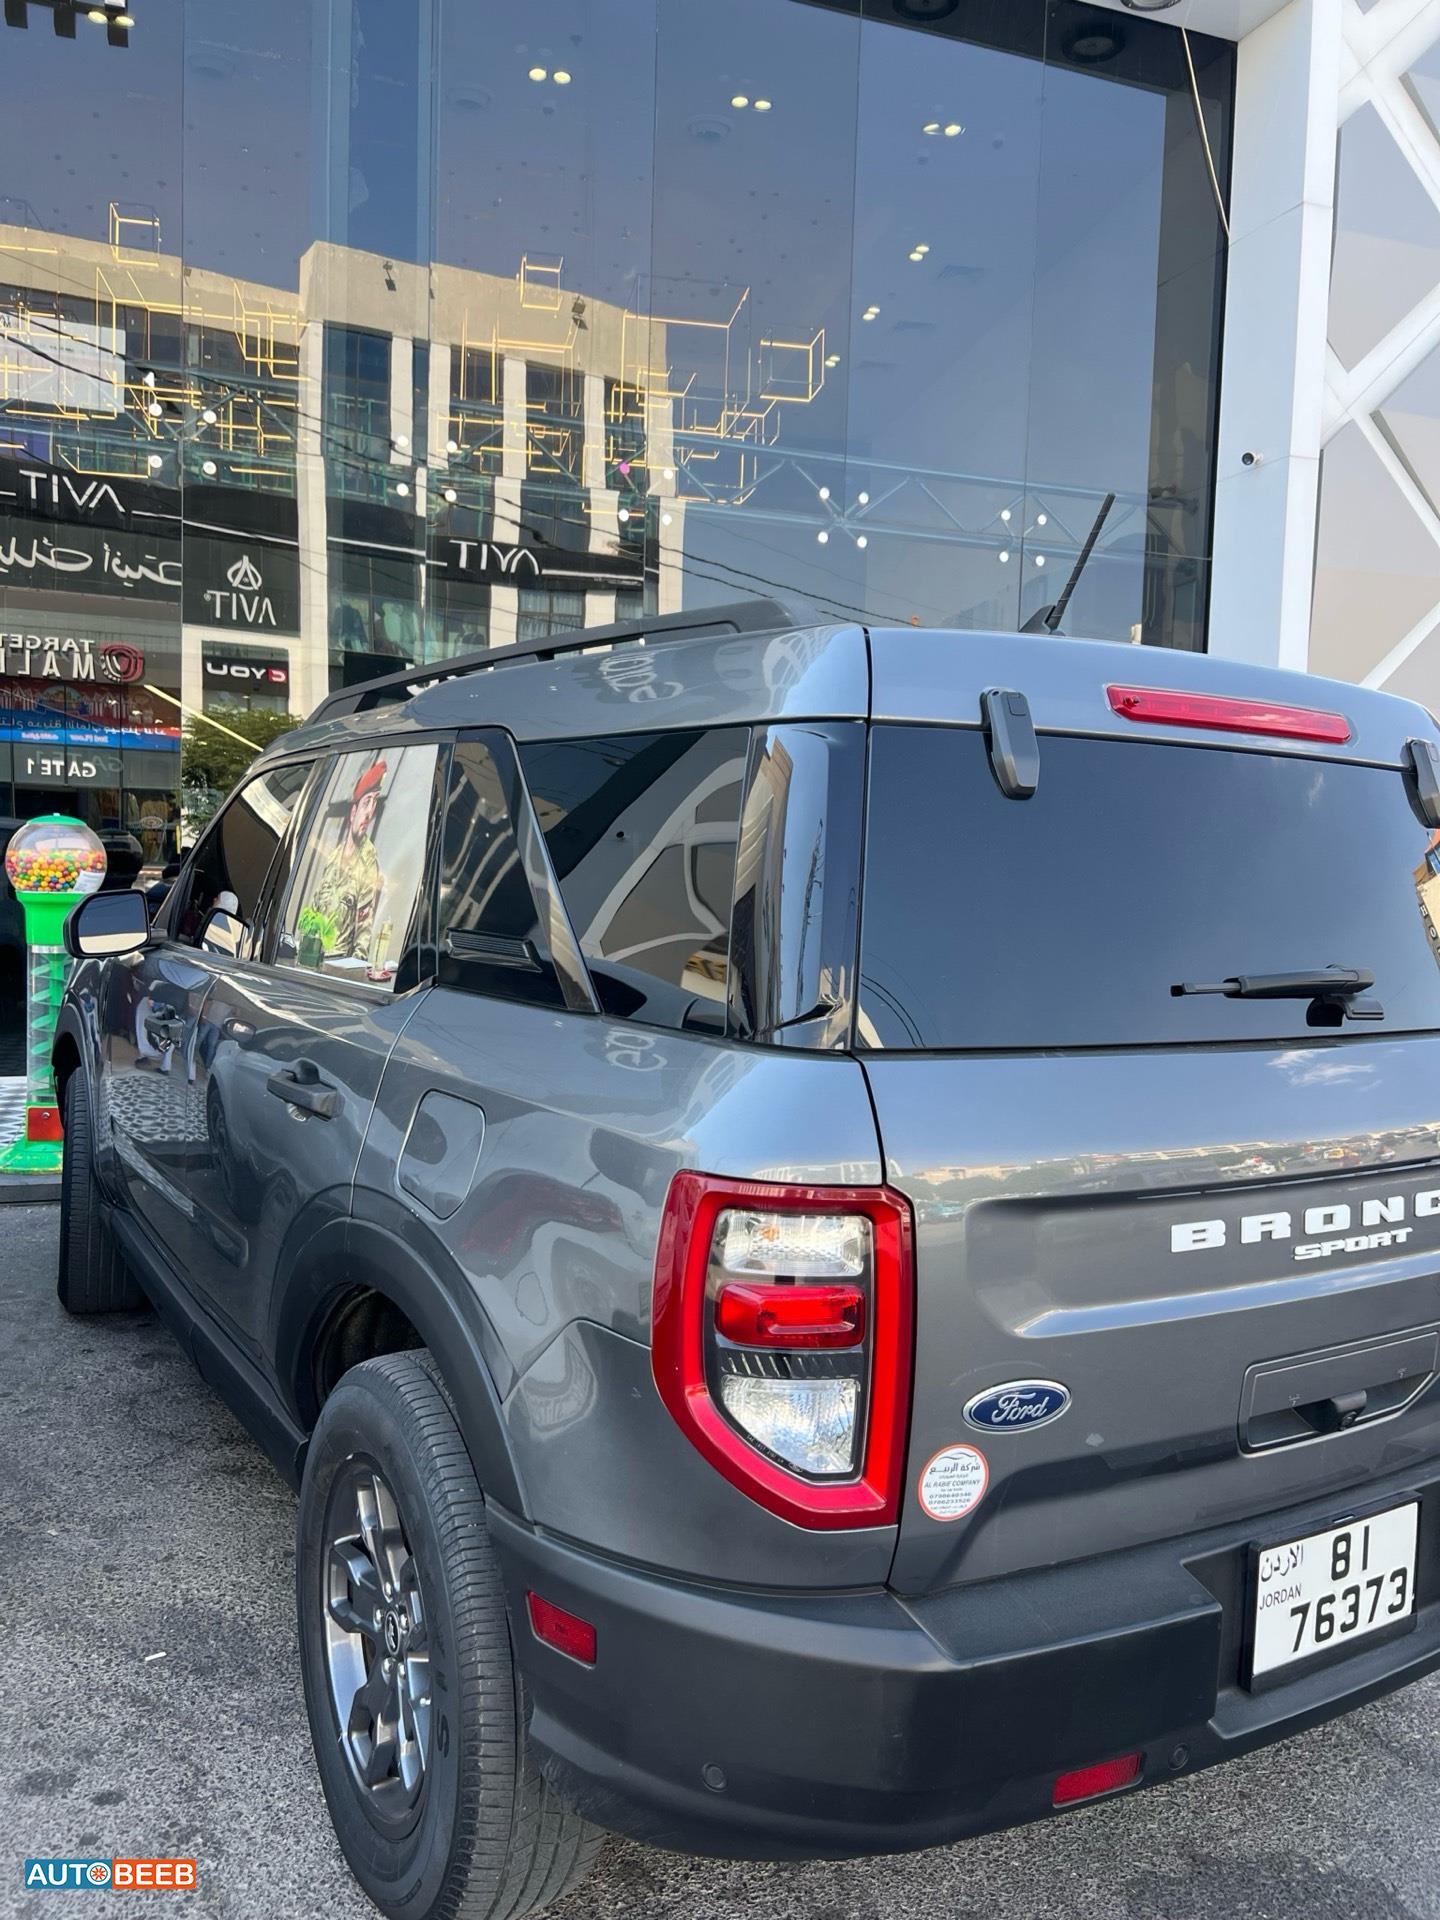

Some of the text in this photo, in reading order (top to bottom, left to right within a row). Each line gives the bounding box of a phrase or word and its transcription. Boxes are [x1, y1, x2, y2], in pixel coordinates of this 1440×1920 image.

[1293, 1226, 1413, 1261] SPORT
[991, 1392, 1050, 1423] Ford
[1331, 1525, 1370, 1581] 81
[1259, 1583, 1302, 1610] JORDAN
[1290, 1566, 1408, 1653] 76373
